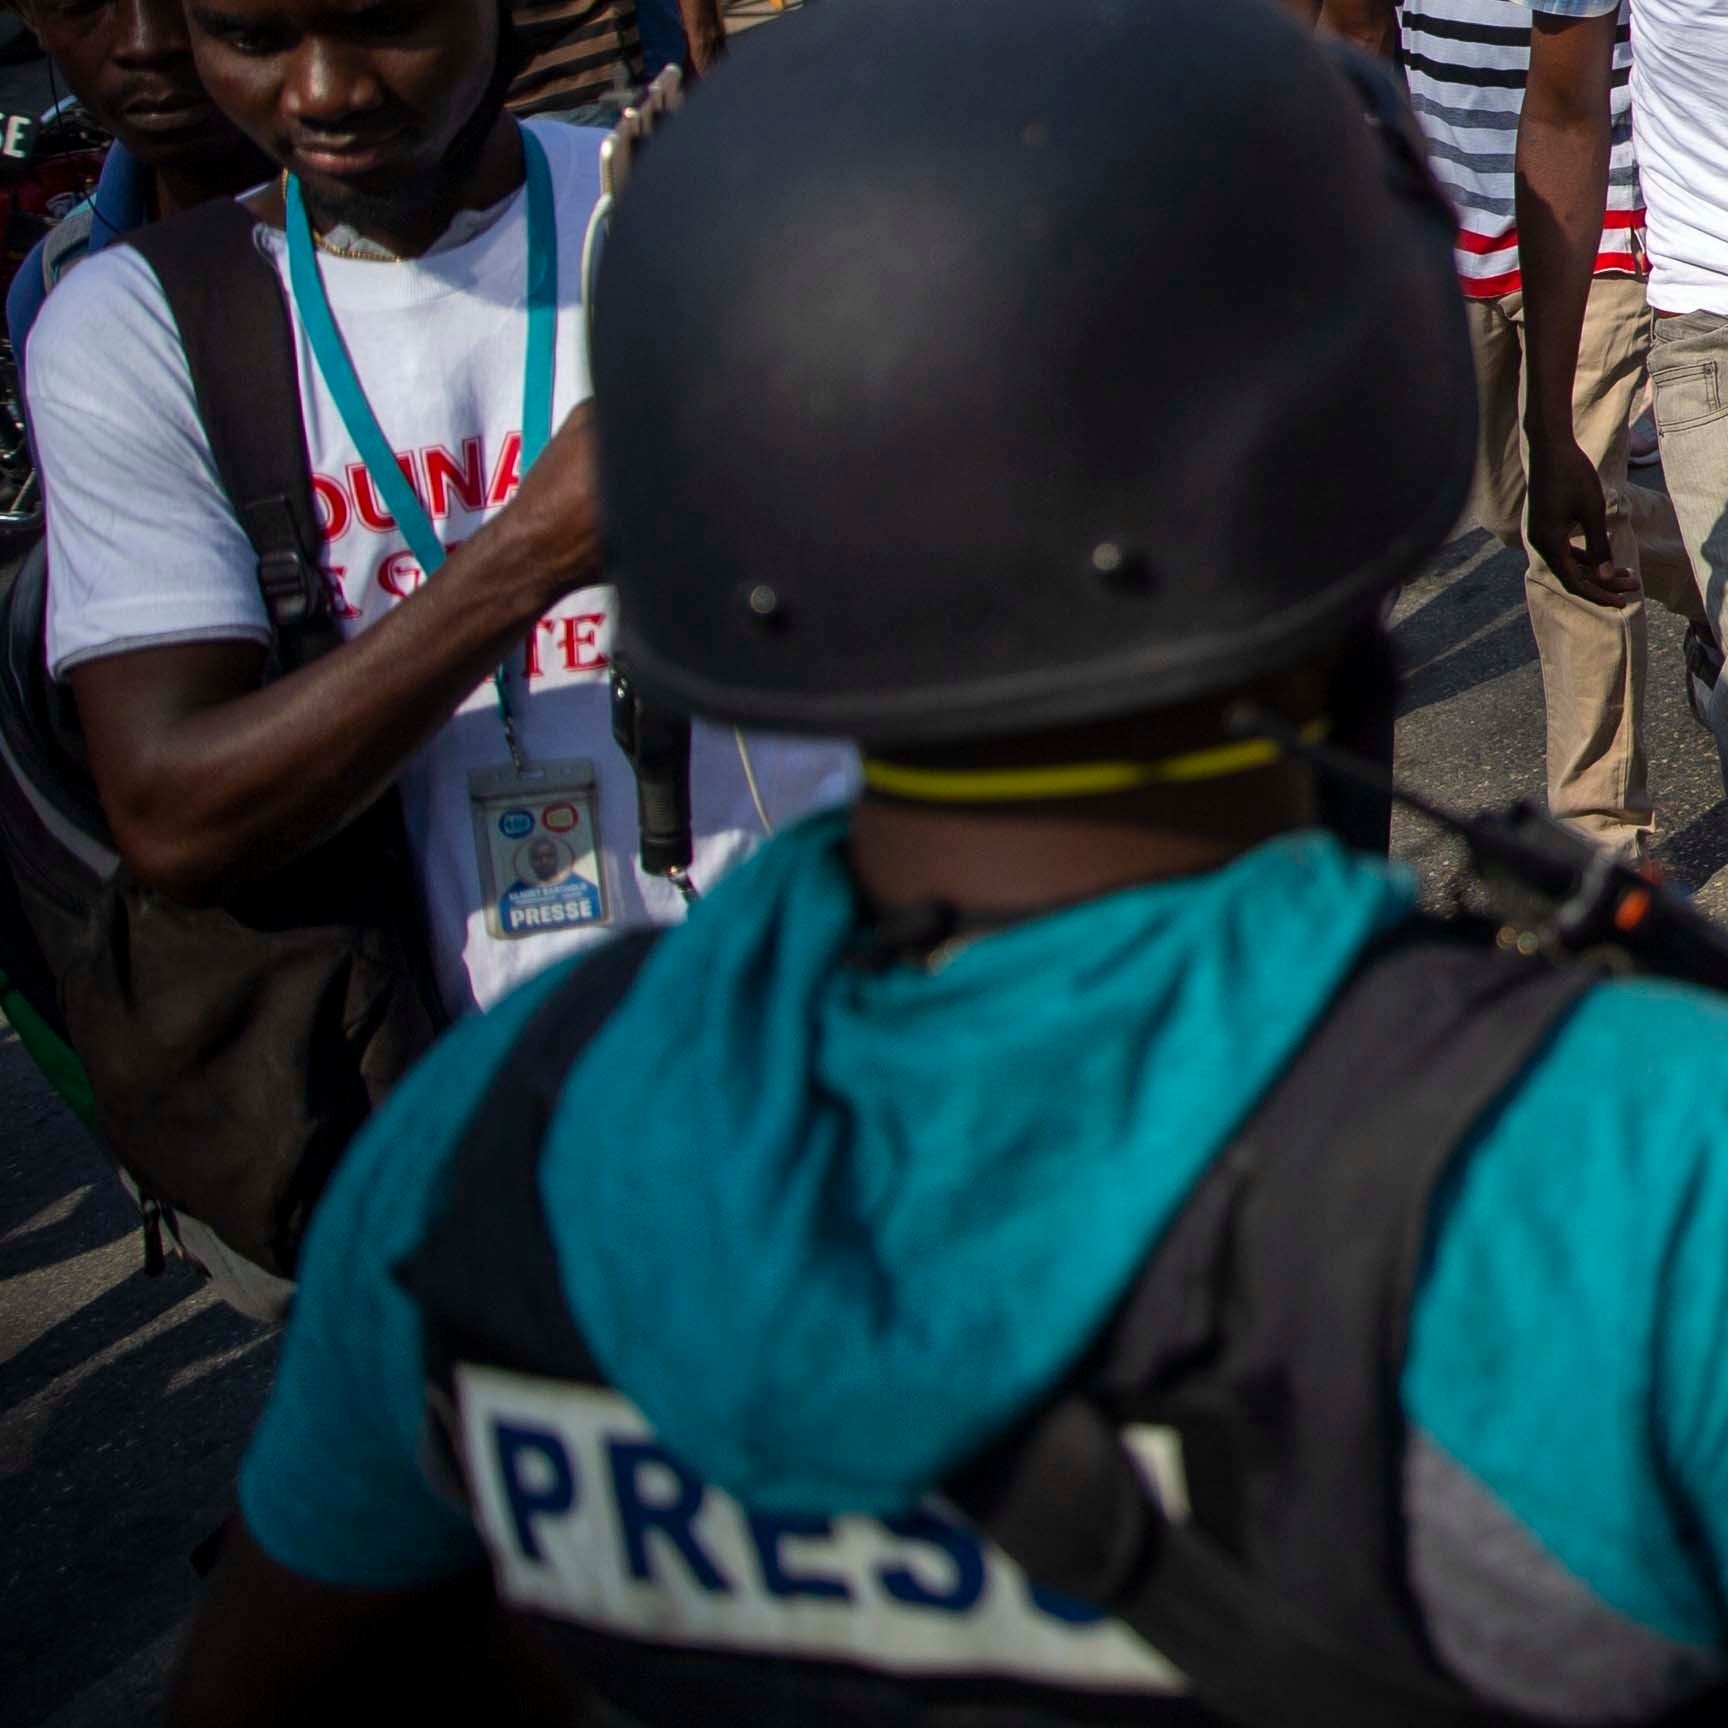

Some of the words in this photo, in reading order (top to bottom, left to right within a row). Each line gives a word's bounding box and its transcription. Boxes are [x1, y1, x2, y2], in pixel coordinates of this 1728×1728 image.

[313, 430, 524, 546] OUNA
[509, 898, 593, 929] PRESSE
[491, 1415, 1115, 1629] PRES
